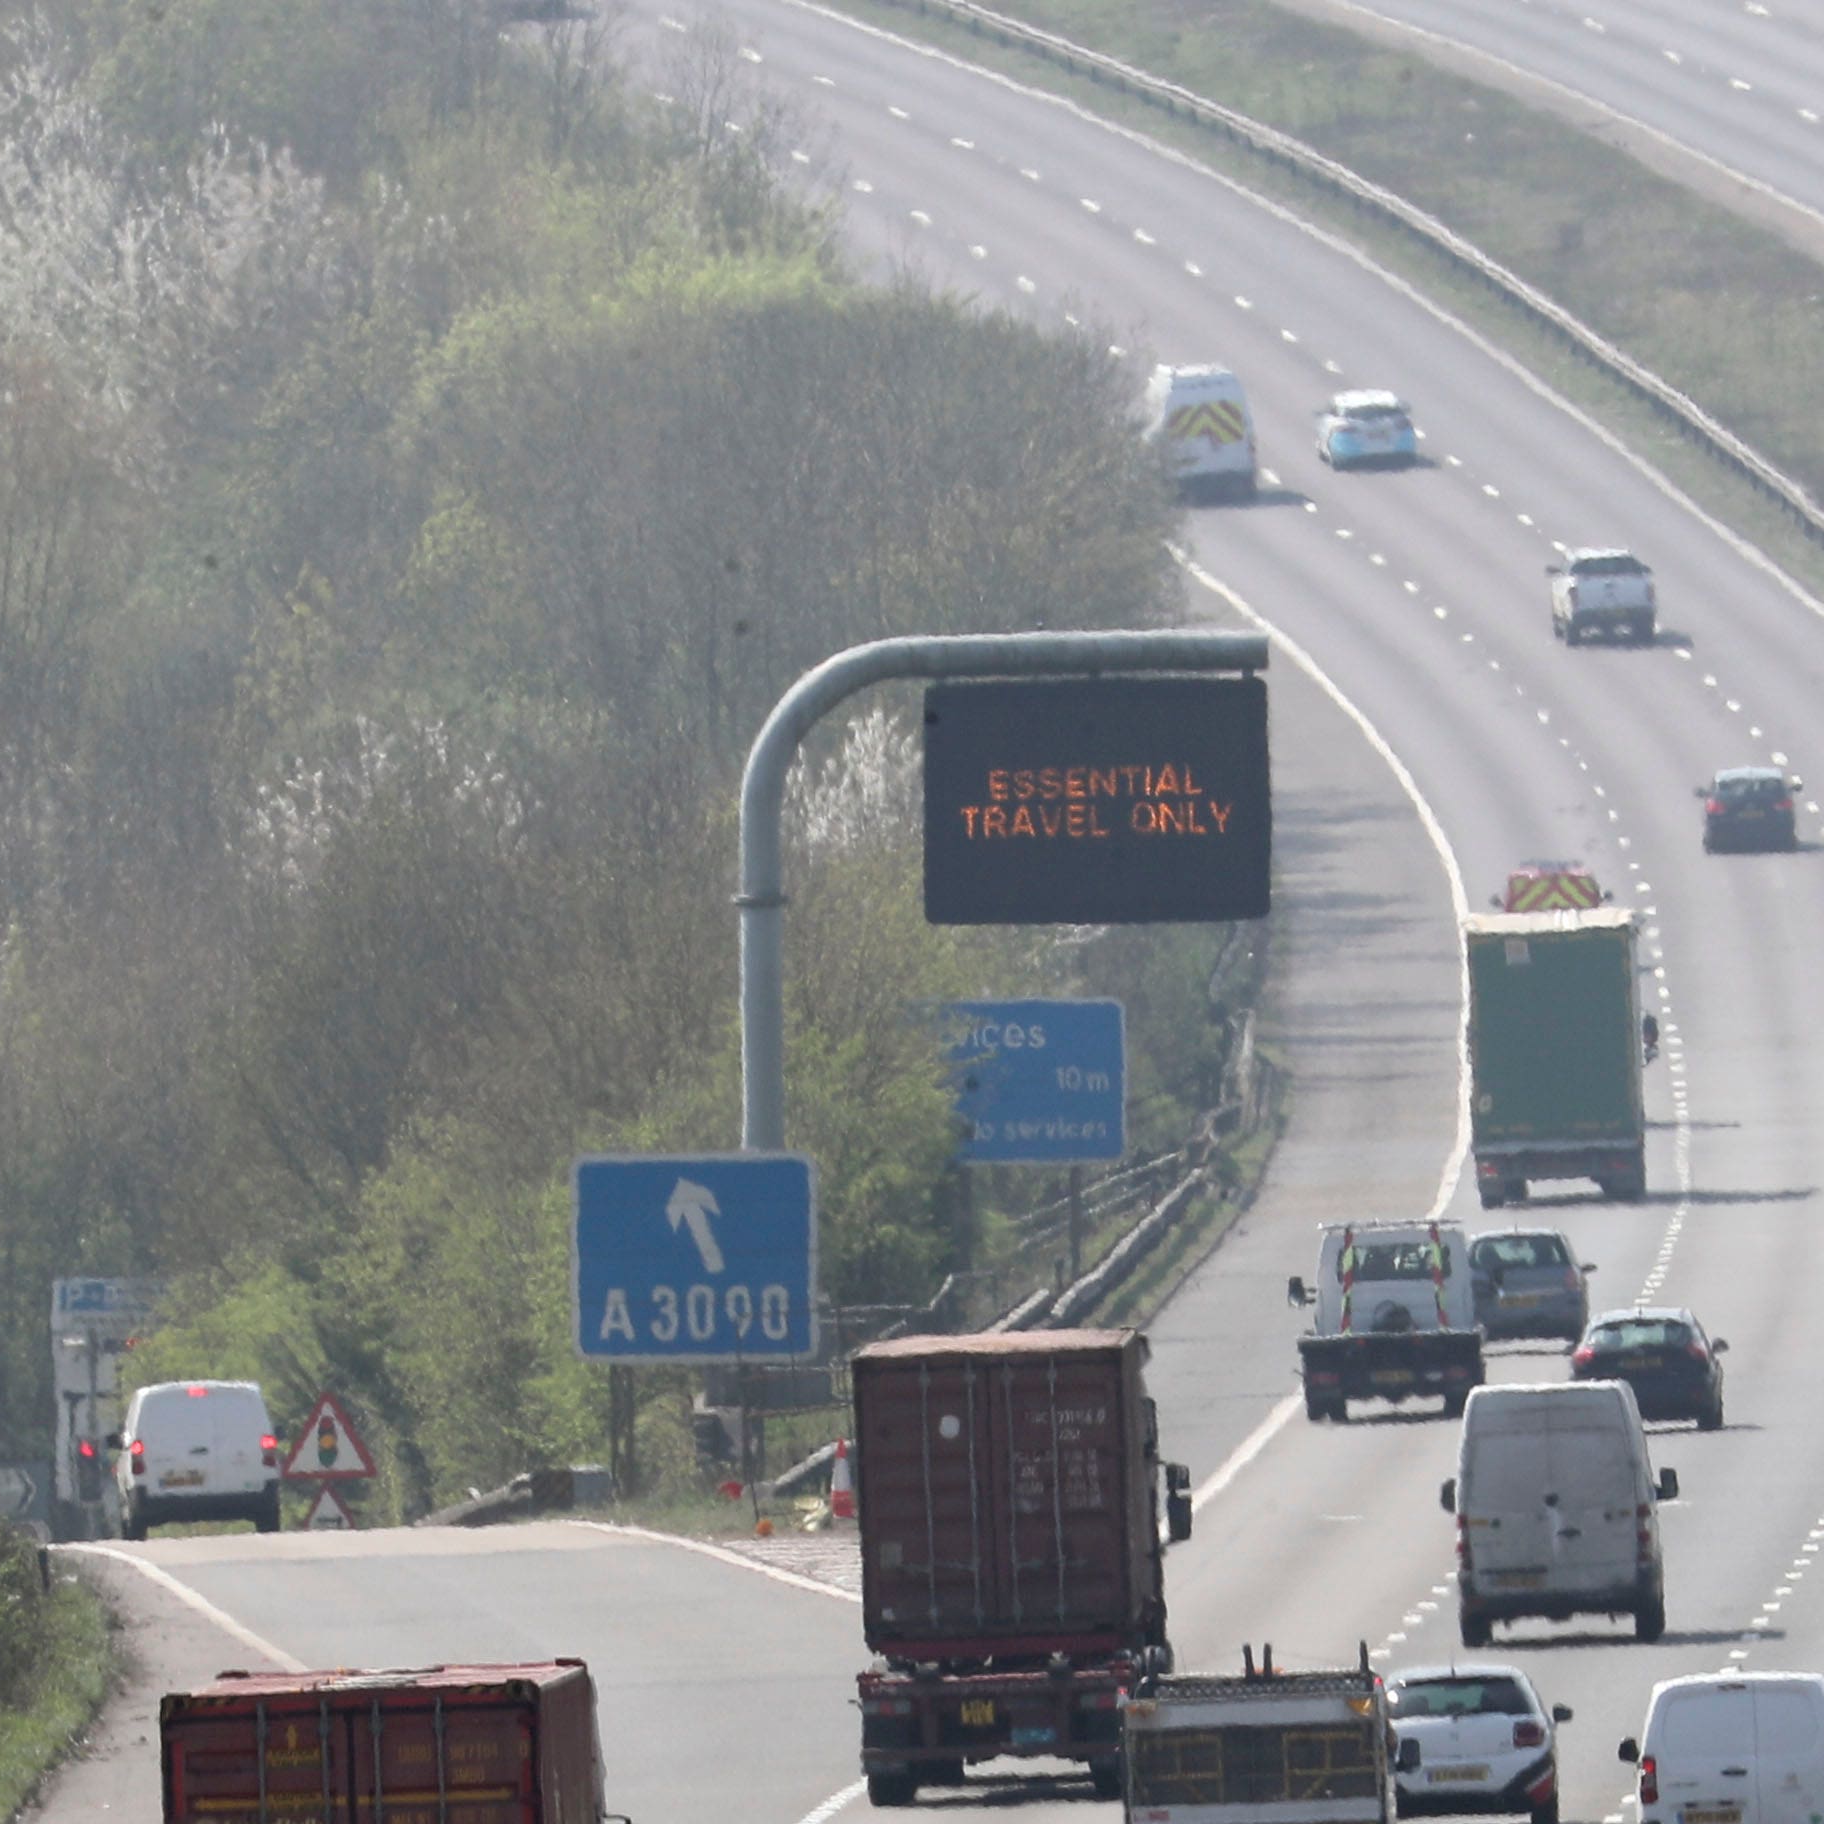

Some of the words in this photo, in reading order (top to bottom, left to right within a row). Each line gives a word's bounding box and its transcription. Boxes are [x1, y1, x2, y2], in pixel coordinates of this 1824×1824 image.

[988, 763, 1203, 801] ESSENTIAL
[960, 804, 1111, 840] TRAVEL
[1130, 800, 1233, 836] ONLY
[1004, 1116, 1107, 1142] services
[649, 1284, 790, 1342] 3090
